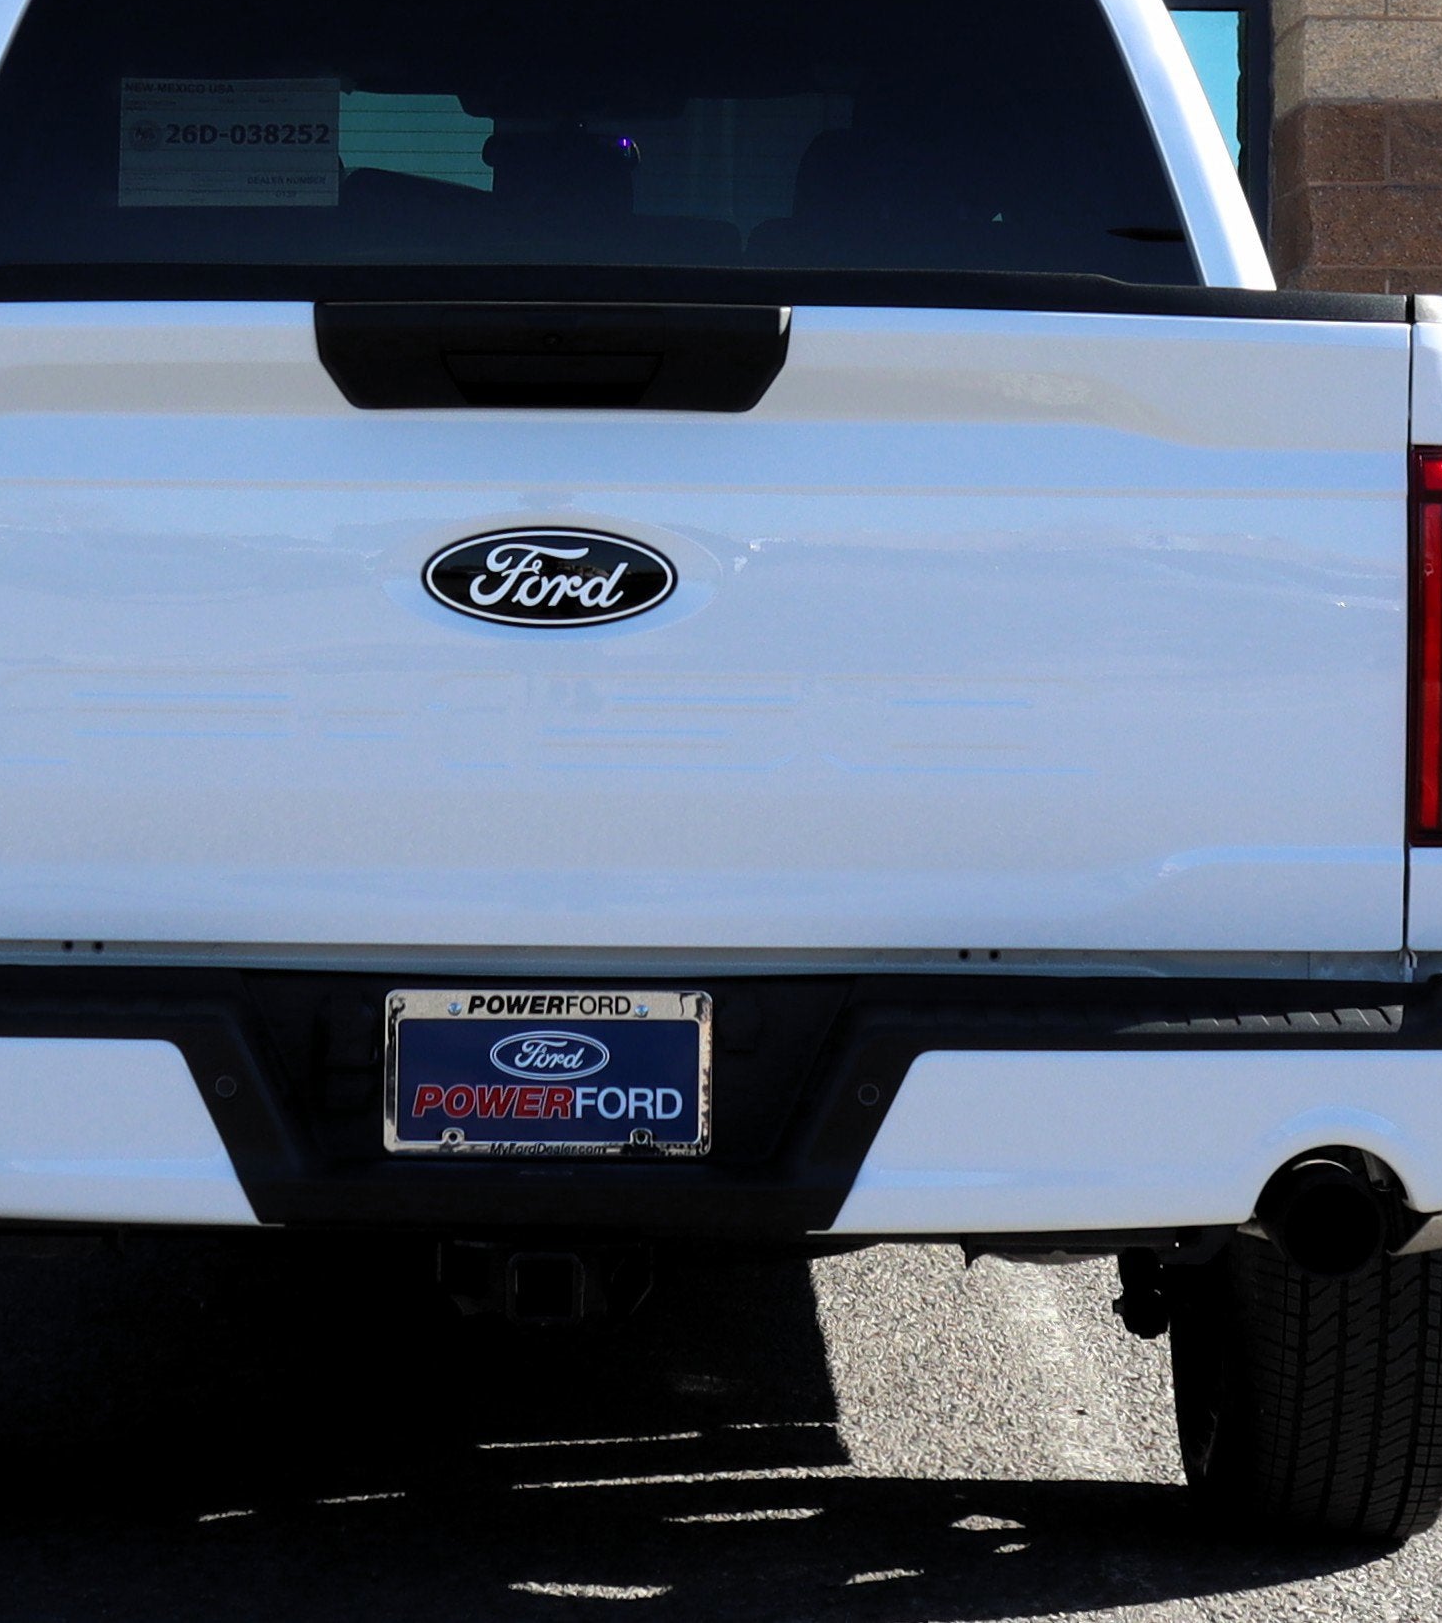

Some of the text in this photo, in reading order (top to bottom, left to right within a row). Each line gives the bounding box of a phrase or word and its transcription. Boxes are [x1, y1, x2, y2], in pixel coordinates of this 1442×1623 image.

[125, 83, 235, 94] NEW MEXICO USA
[165, 123, 331, 145] 26D-038252
[247, 175, 326, 185] DEALER NUMBER
[470, 543, 629, 608] Ford
[467, 995, 631, 1015] POWERFORD
[514, 1039, 585, 1069] Ford
[413, 1084, 683, 1120] POWERFORD
[489, 1142, 606, 1156] MyFordDealer.com
